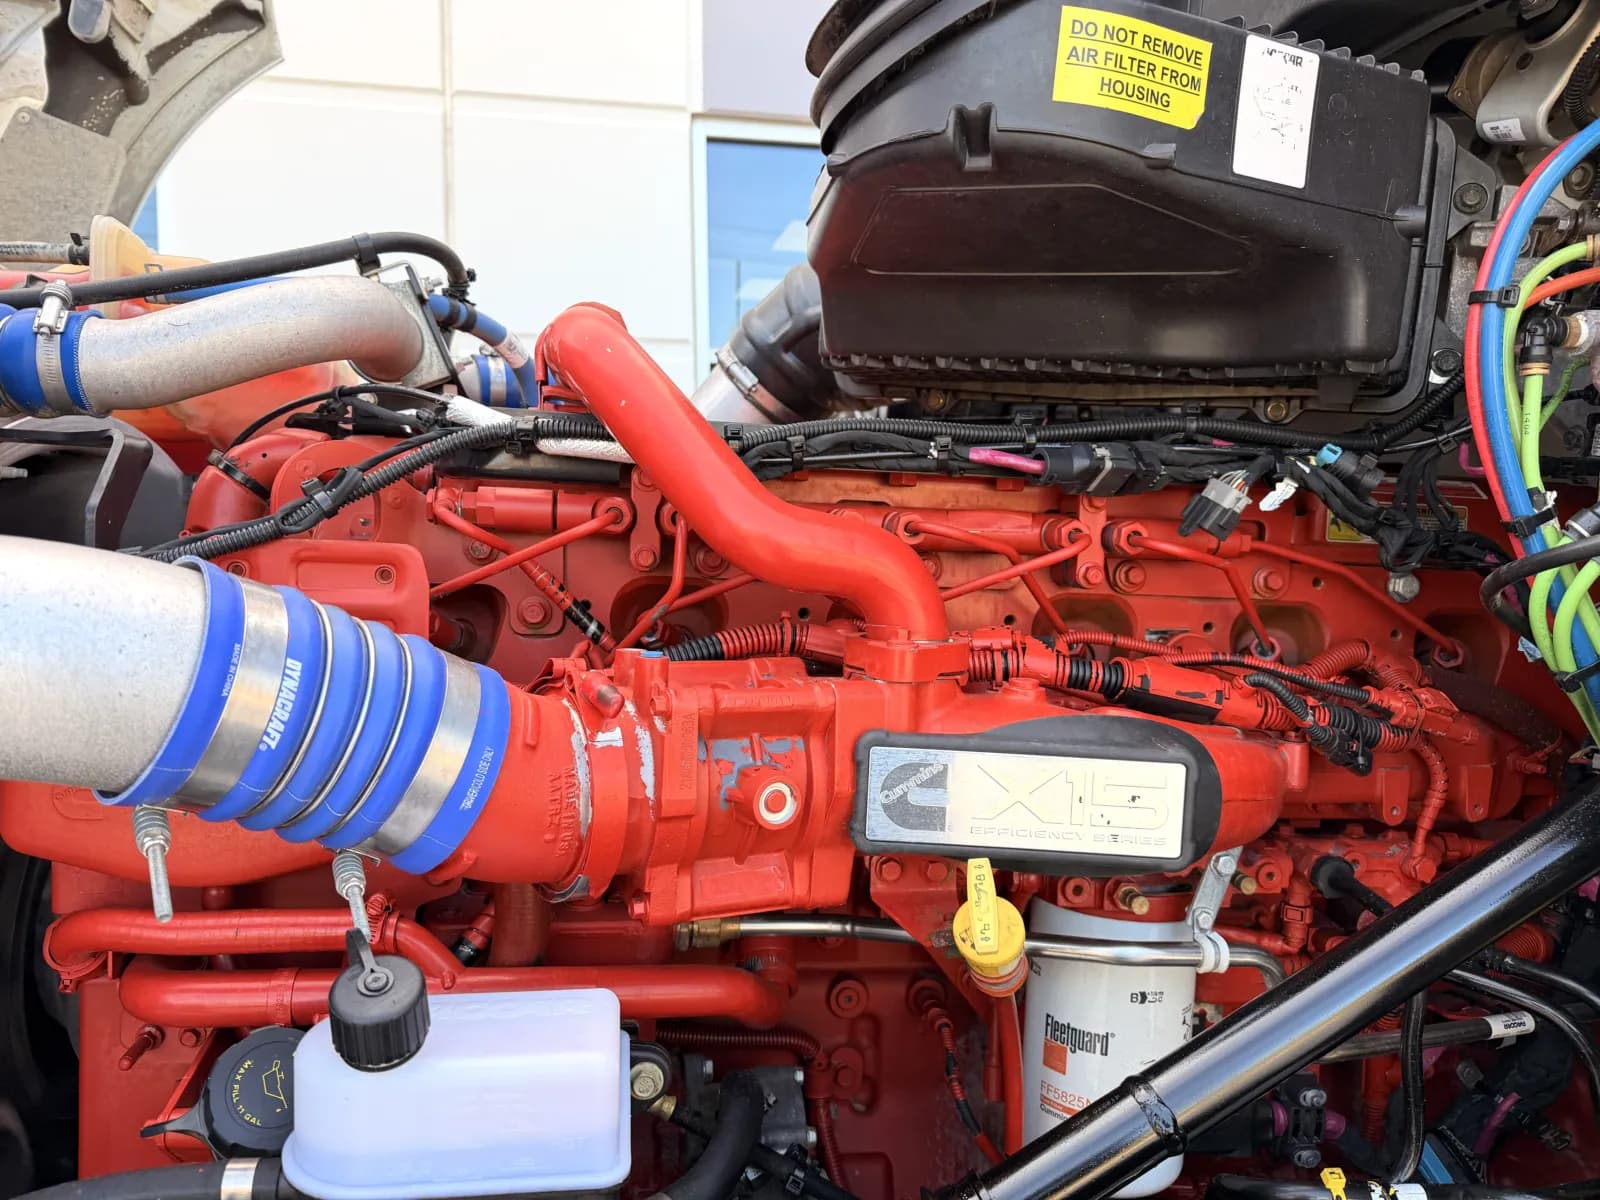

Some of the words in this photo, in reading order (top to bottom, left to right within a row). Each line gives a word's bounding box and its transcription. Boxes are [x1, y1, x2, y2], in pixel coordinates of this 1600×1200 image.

[1071, 19, 1098, 37] DO
[1103, 24, 1139, 46] NOT
[1142, 33, 1204, 67] REMOVE
[1067, 46, 1099, 64] AIR
[1104, 51, 1156, 79] FILTER
[1160, 67, 1202, 92] FROM
[1100, 77, 1171, 108] HOUSING
[231, 643, 241, 664] MADE
[229, 664, 237, 673] IN
[221, 673, 235, 698] CHINA
[262, 657, 303, 750] DYNACRAFT
[880, 762, 945, 803] Cummins
[970, 824, 1086, 842] EFFICIENCY
[1093, 833, 1169, 846] SERIES
[1045, 1013, 1109, 1056] Fleetguard
[235, 1060, 254, 1081] MAX
[244, 1113, 262, 1126] GAL
